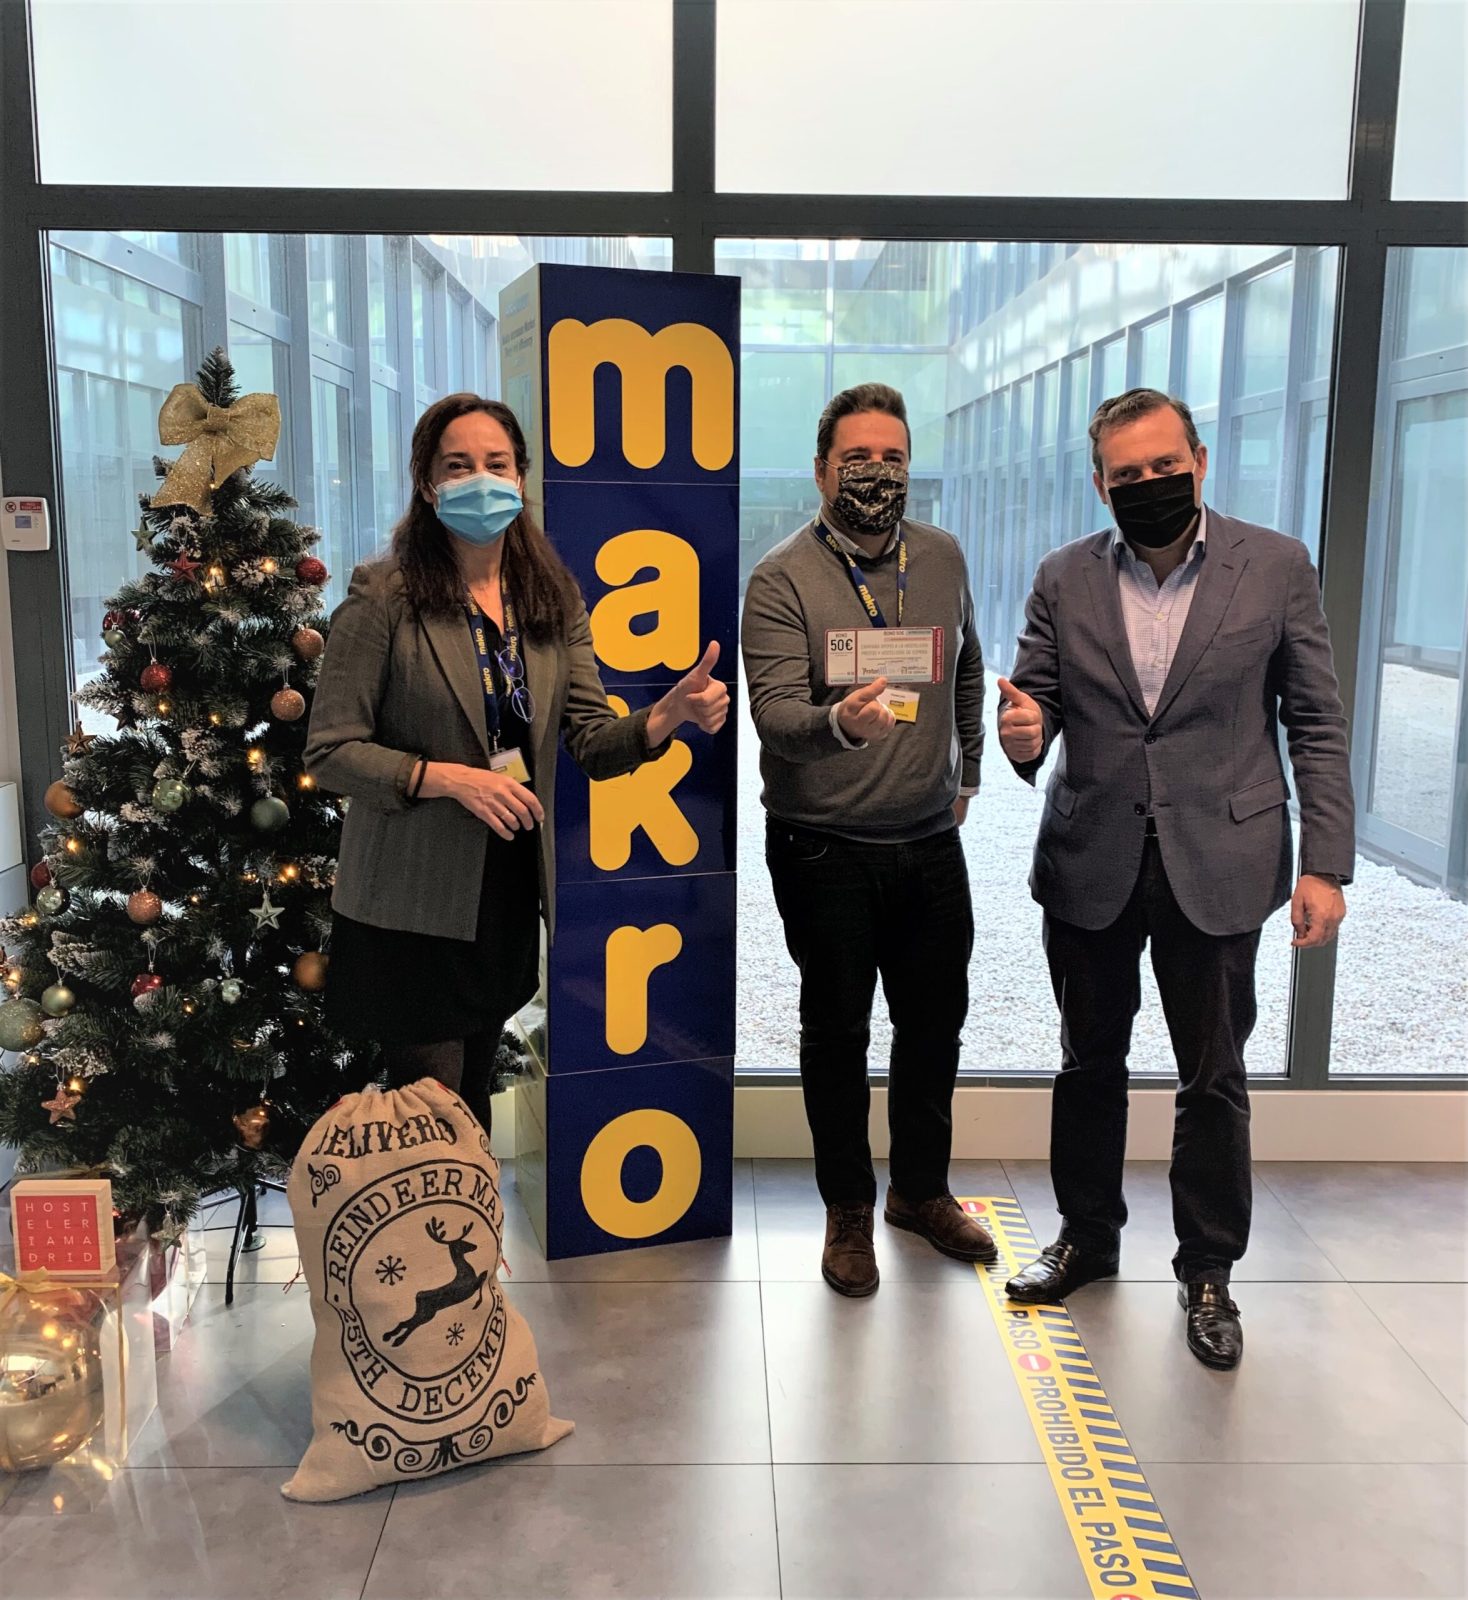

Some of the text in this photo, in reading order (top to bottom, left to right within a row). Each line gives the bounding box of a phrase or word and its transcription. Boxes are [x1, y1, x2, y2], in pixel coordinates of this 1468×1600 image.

[899, 541, 907, 573] makro
[859, 584, 878, 617] makro
[475, 628, 487, 655] makro
[830, 639, 853, 651] 50€
[482, 667, 494, 695] makro
[329, 1168, 464, 1286] REINDEER
[1001, 1310, 1041, 1350] PASO
[339, 1308, 388, 1390] 25TH
[1026, 1376, 1137, 1587] PROHIBIDO EL PASO
